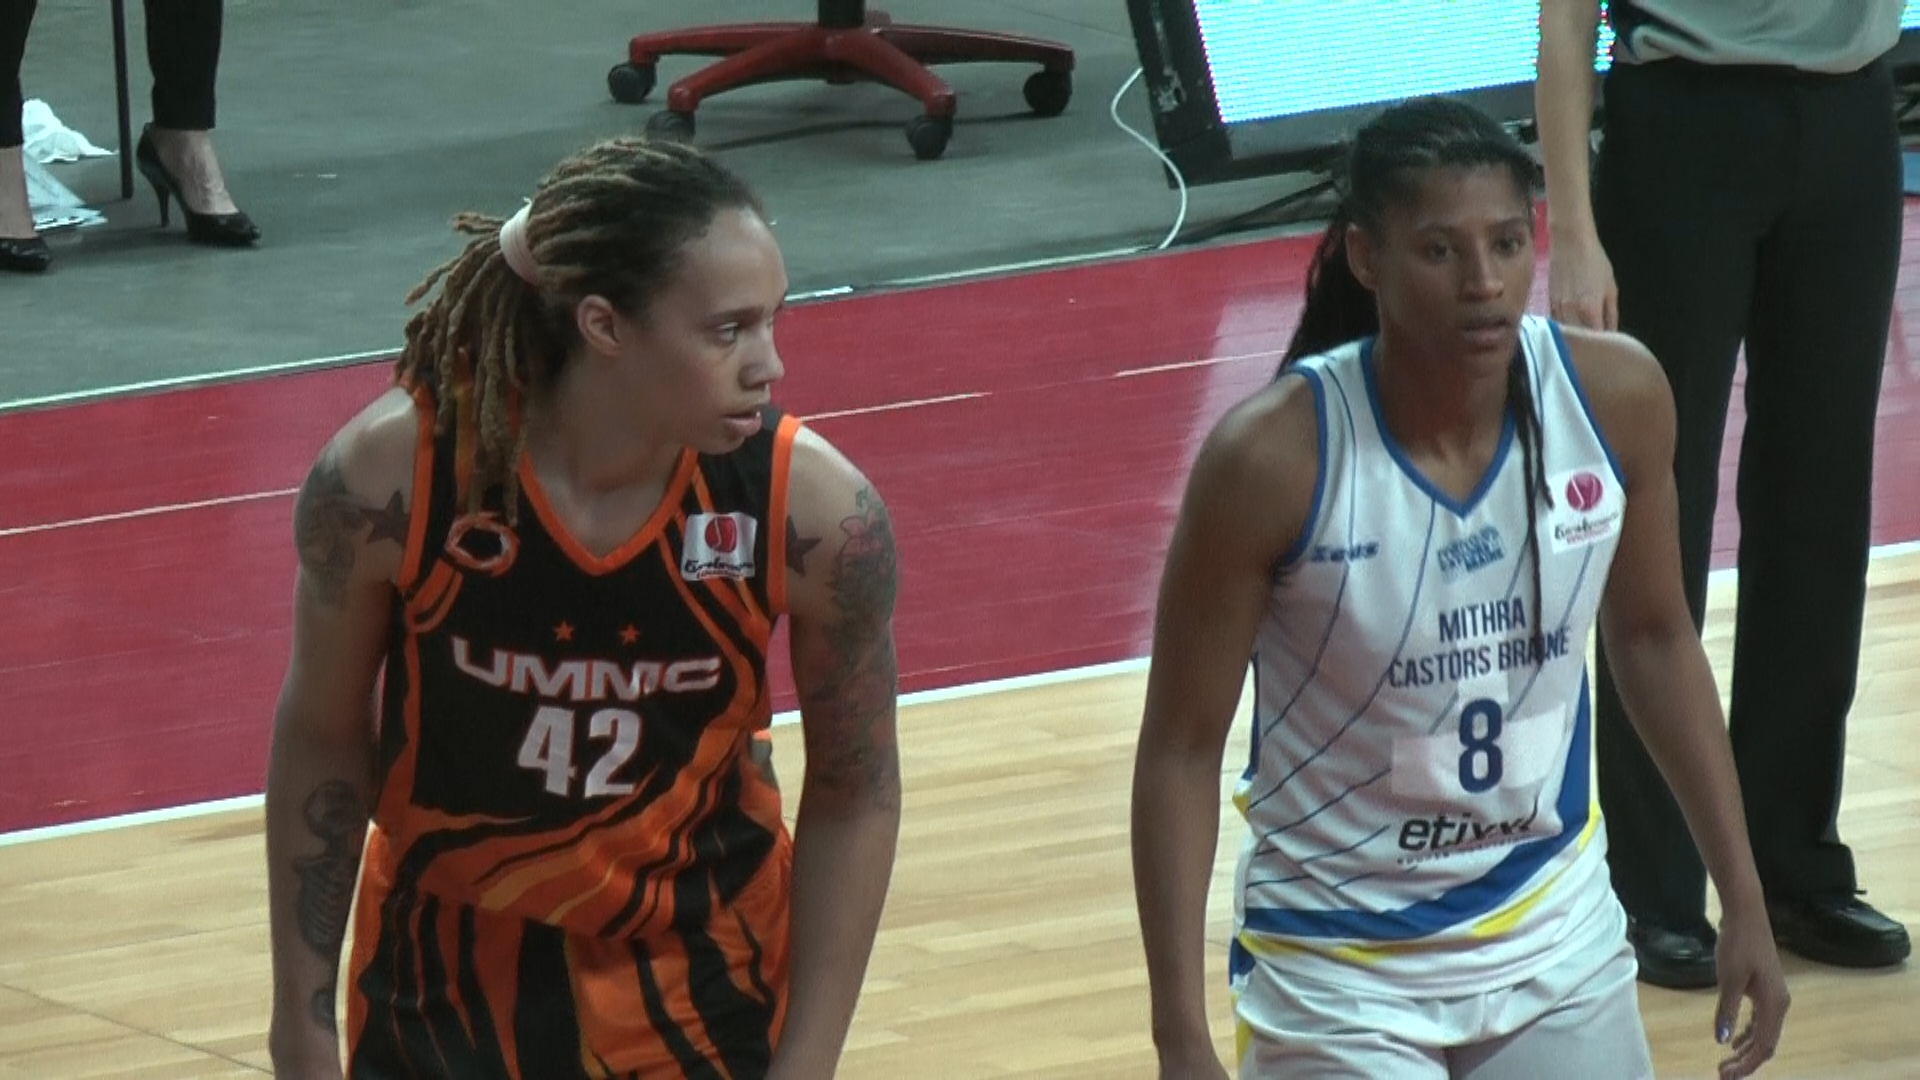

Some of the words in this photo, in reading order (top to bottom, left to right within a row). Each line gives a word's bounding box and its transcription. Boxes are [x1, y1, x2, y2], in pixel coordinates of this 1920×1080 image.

[1438, 597, 1526, 643] MITHRA
[451, 635, 719, 701] UMMC
[1388, 645, 1491, 688] CASTORS
[517, 704, 642, 798] 42
[1458, 698, 1503, 793] 8
